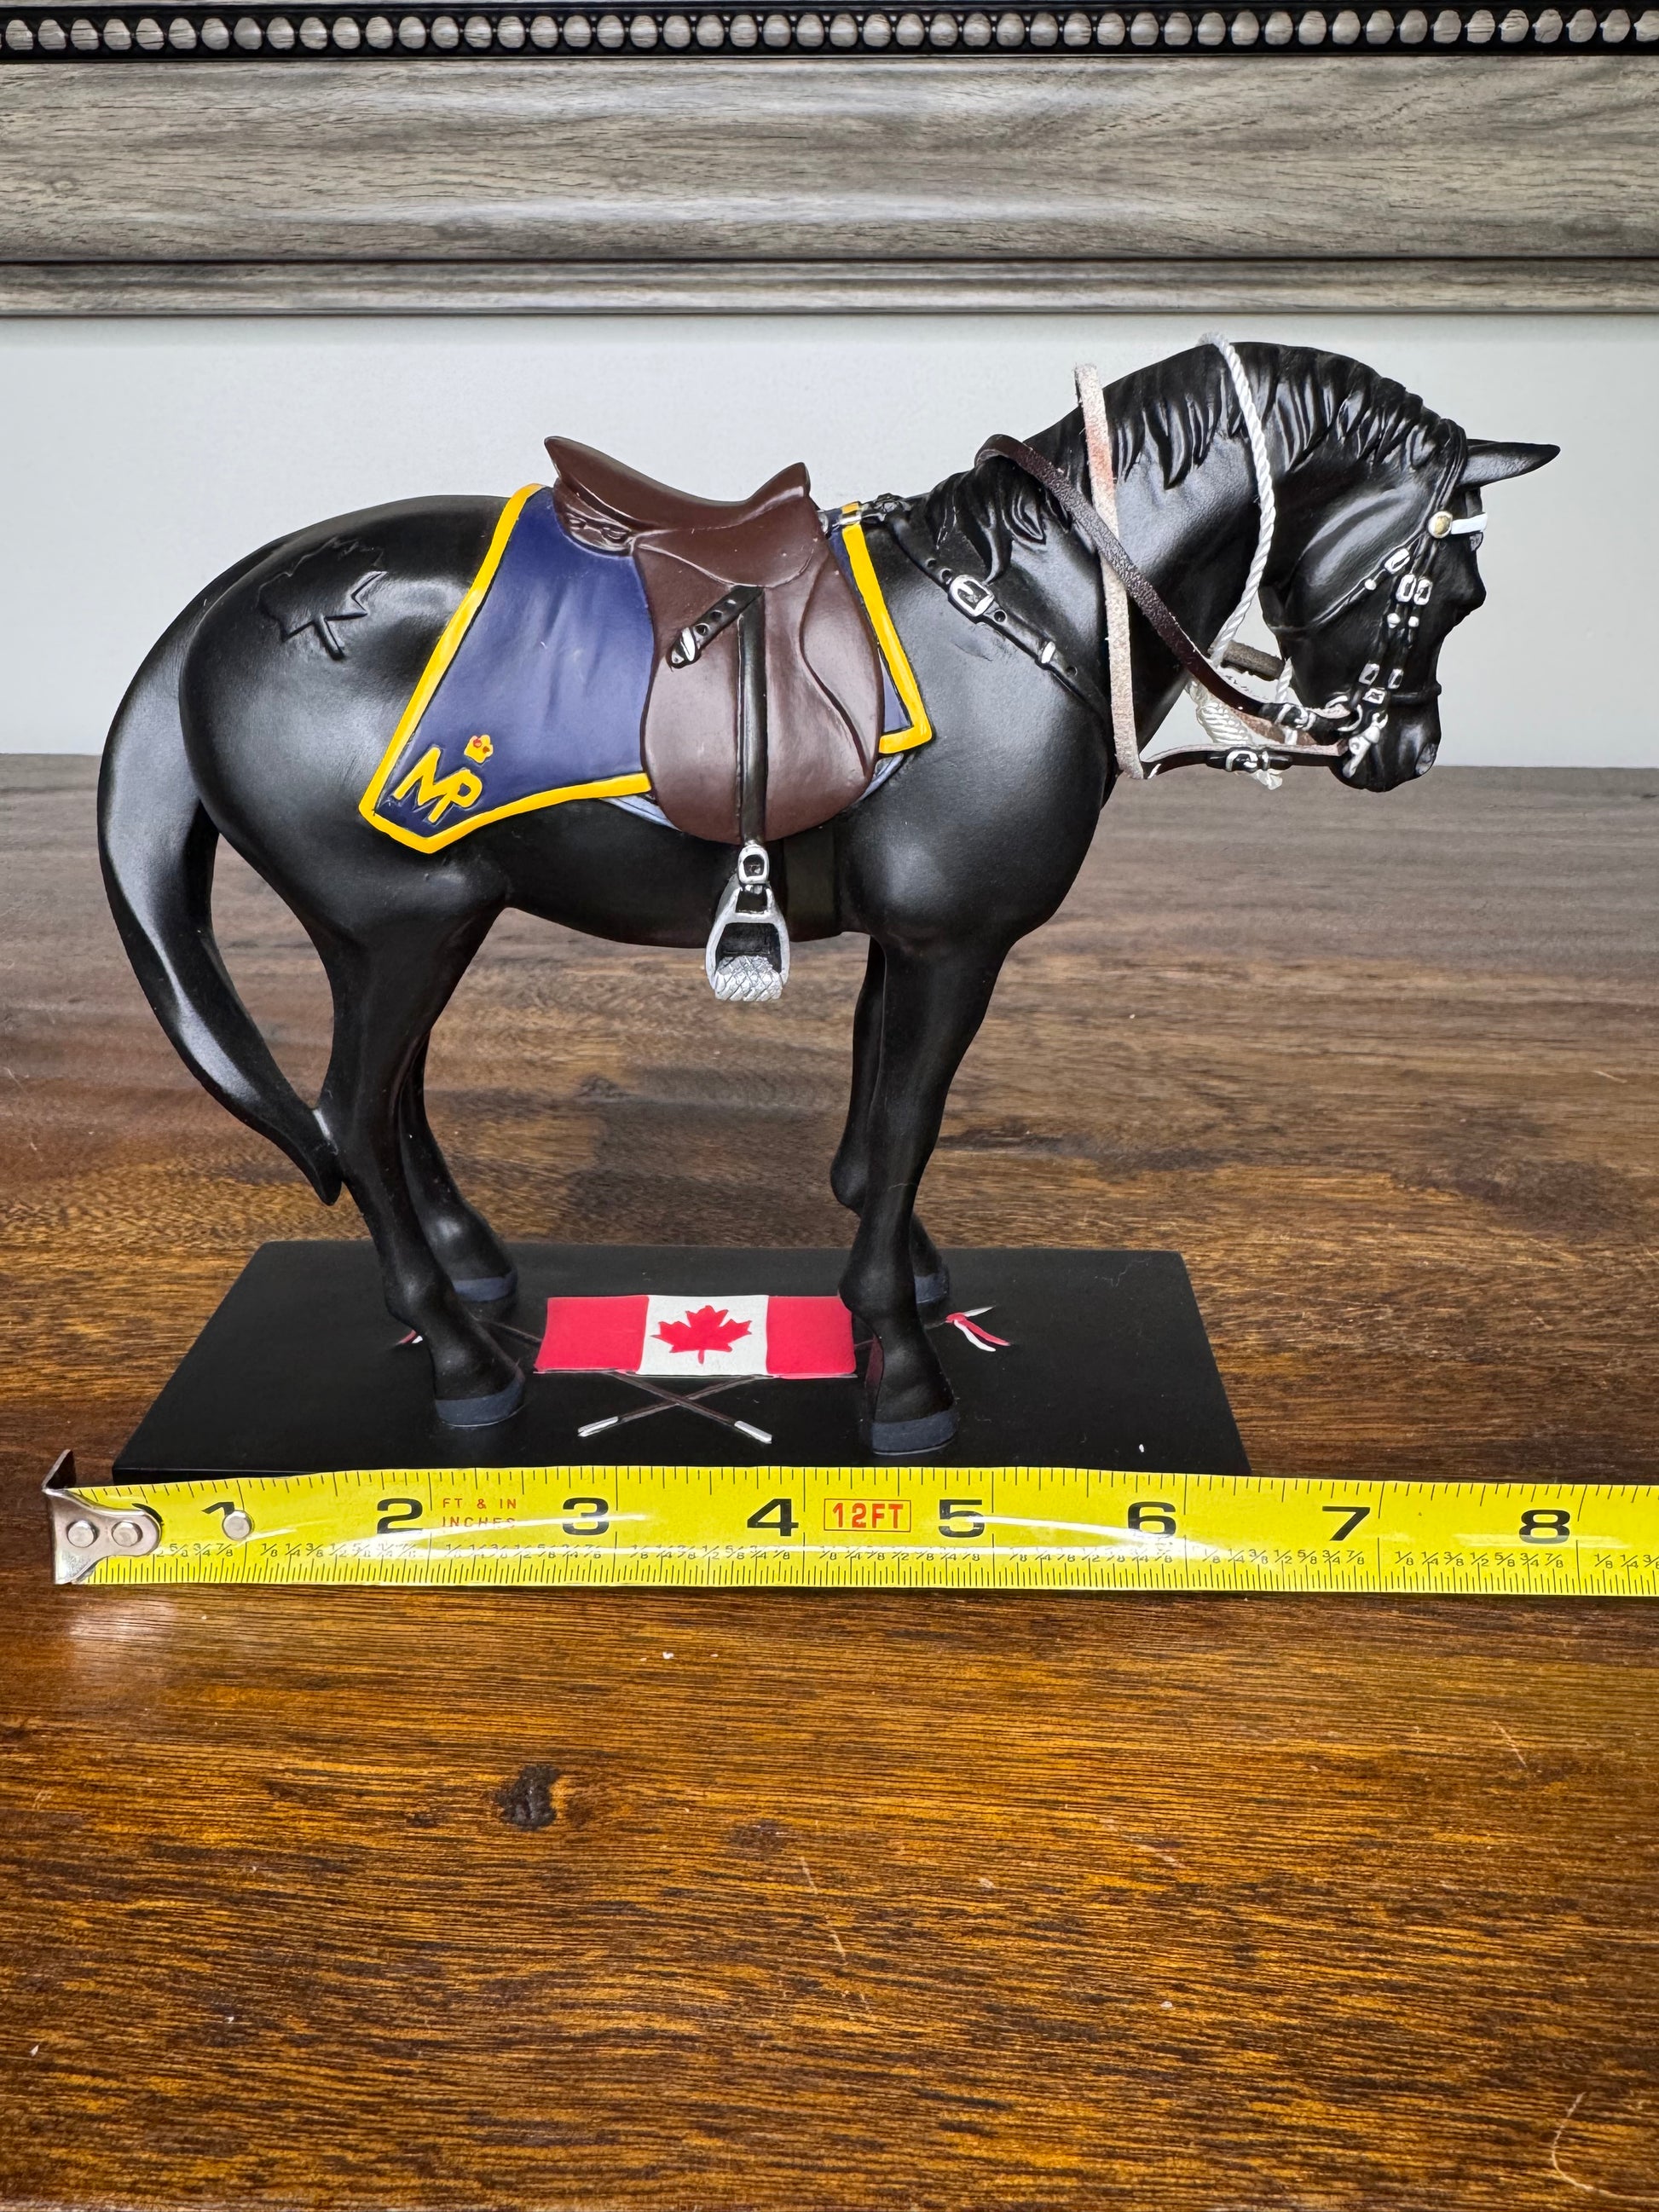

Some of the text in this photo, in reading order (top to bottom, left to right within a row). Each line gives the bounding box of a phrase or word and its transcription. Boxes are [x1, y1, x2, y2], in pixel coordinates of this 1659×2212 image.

[442, 1498, 517, 1510] FT & IN
[376, 1498, 424, 1534] 2
[442, 1516, 516, 1528] INCHES
[563, 1497, 610, 1535] 3
[747, 1499, 799, 1536] 4
[832, 1503, 905, 1528] 12FT
[938, 1499, 986, 1538] 5
[1127, 1501, 1177, 1536] 6
[1321, 1506, 1371, 1541] 7
[1518, 1509, 1571, 1544] 8
[194, 1543, 211, 1556] 3/4
[217, 1543, 234, 1556] 7/8
[260, 1543, 278, 1556] 1/8
[285, 1543, 303, 1556] 1/4
[305, 1543, 324, 1556] 3/8
[702, 1545, 720, 1559] 1/2
[1228, 1549, 1246, 1563] 1/4
[1249, 1549, 1269, 1563] 3/8
[1275, 1550, 1292, 1564] 1/2
[1297, 1550, 1317, 1564] 5/8
[1322, 1550, 1341, 1564] 3/4
[1346, 1550, 1365, 1564] 7/8
[1395, 1551, 1564, 1568] 1/8 1/4 3/8 1/2 5/8 3/4 7/8
[1593, 1553, 1613, 1568] 1/8
[1620, 1553, 1639, 1568] 1/4
